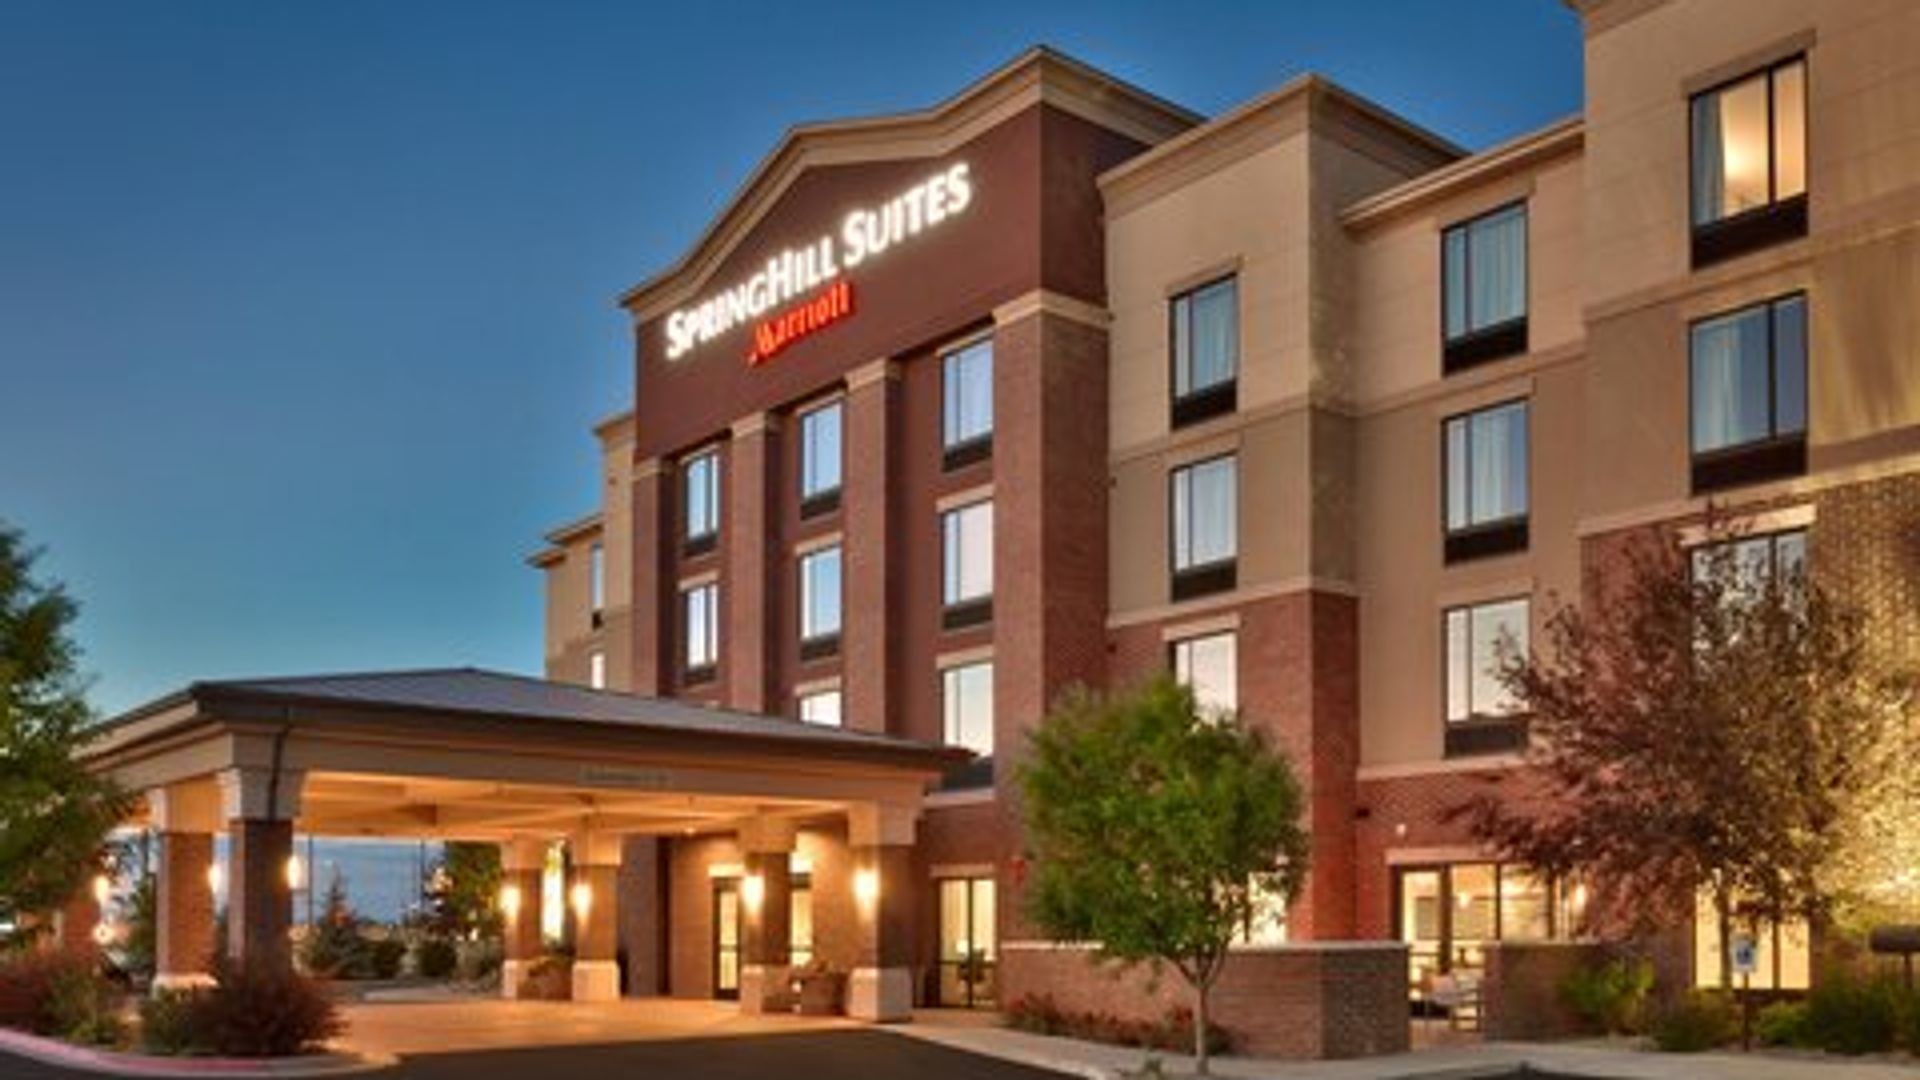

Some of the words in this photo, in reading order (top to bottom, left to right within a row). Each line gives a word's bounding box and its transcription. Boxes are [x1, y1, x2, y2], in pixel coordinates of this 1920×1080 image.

[665, 236, 838, 359] SPRINGHILL
[842, 162, 971, 267] SUITES
[748, 281, 851, 364] Marriott
